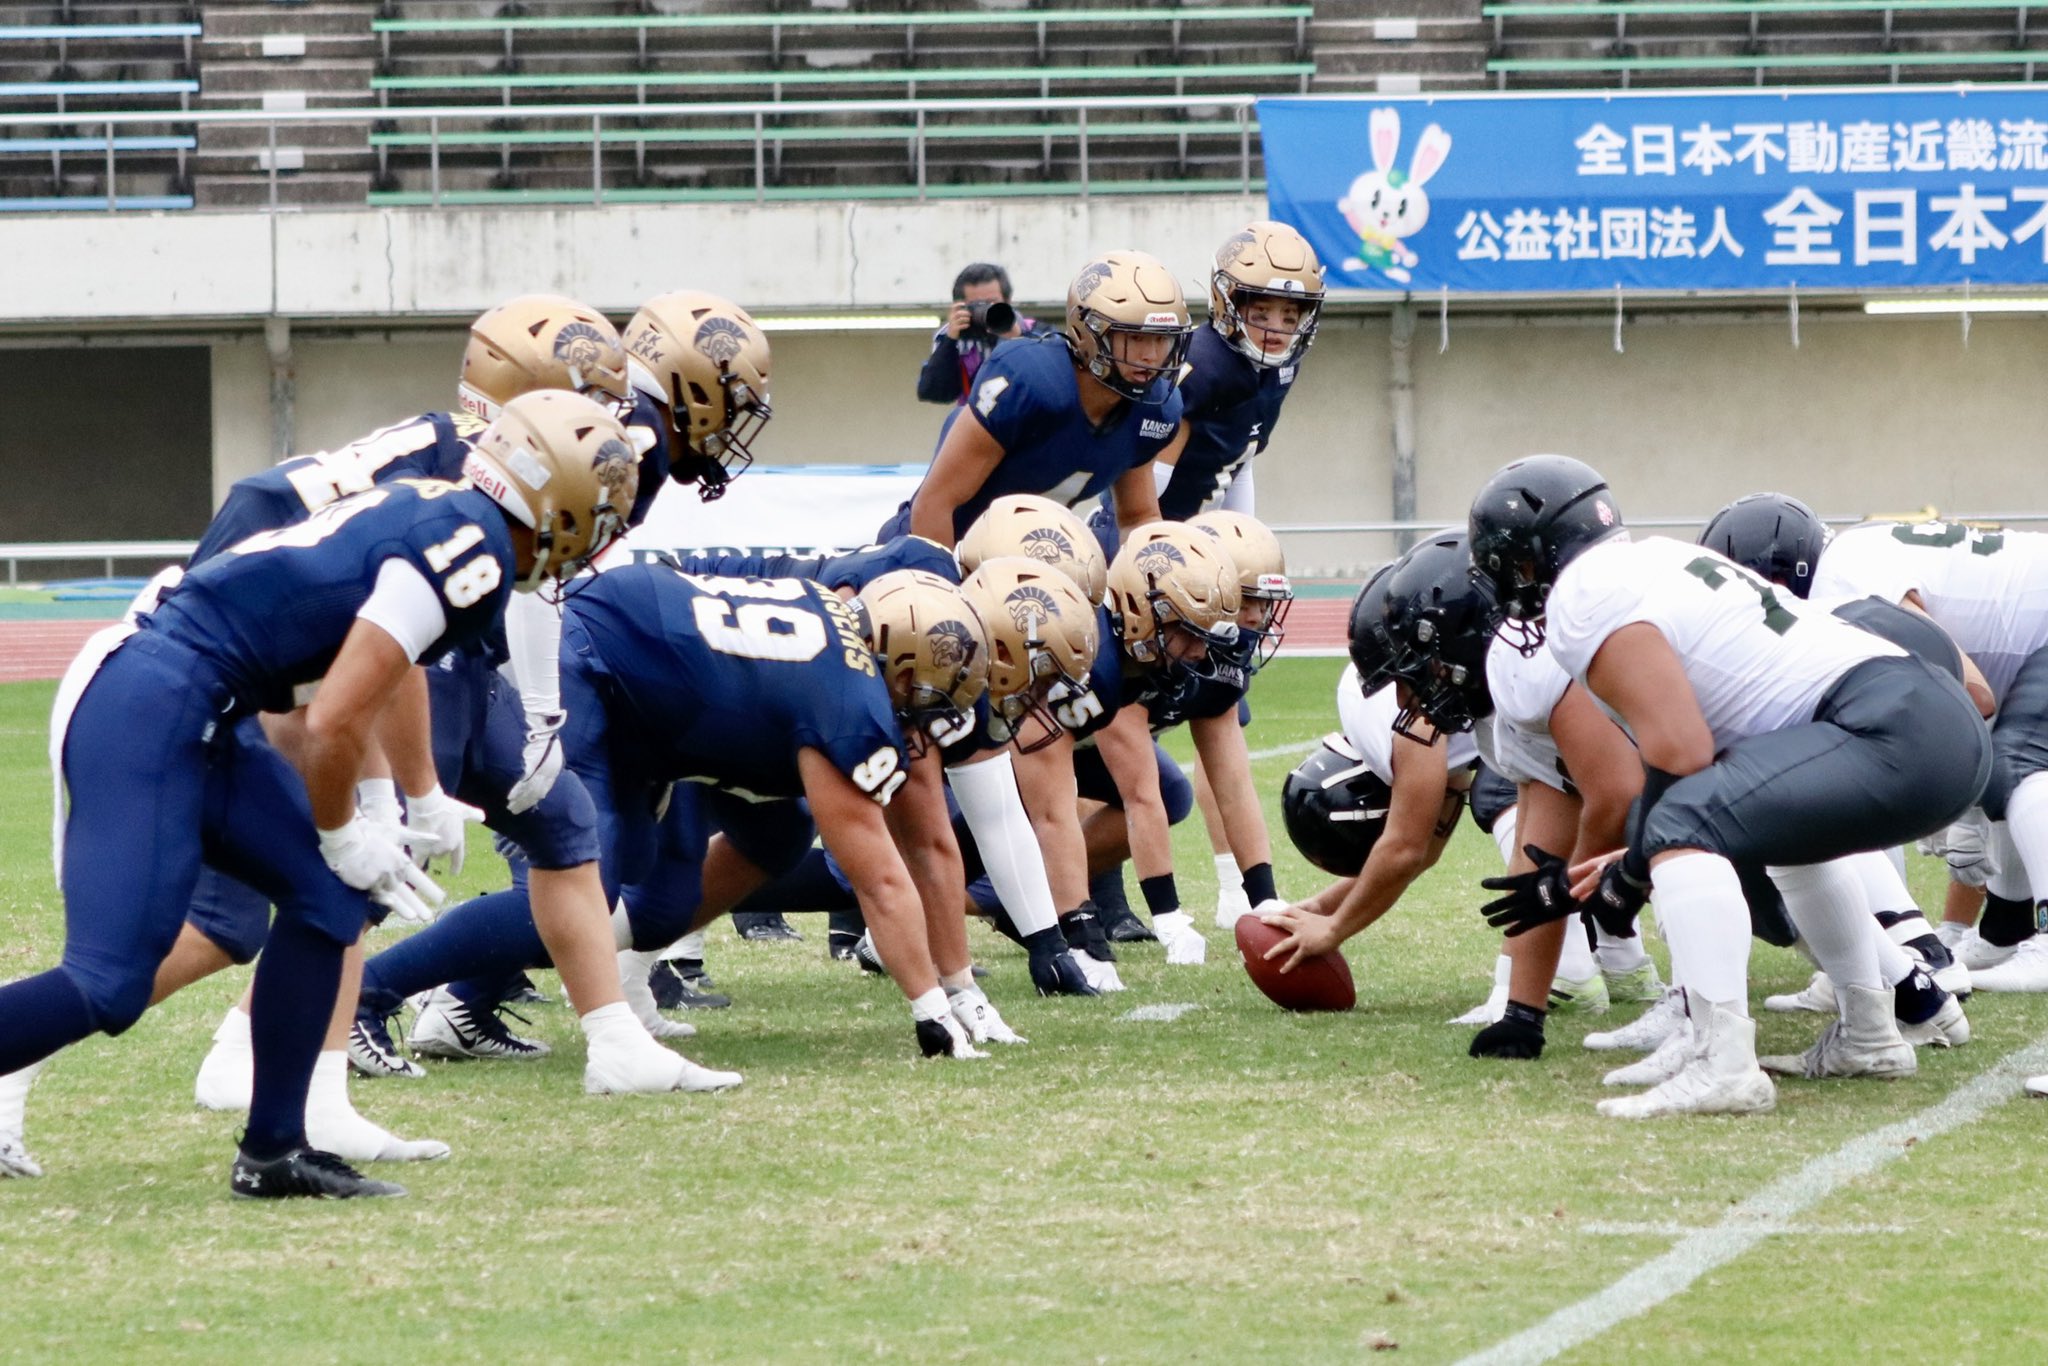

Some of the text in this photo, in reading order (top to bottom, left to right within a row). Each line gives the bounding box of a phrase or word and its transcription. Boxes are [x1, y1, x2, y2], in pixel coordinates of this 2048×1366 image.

[1574, 118, 2048, 176] 全日本不動産近畿流
[1455, 204, 1745, 262] 公益社団法人
[978, 376, 1009, 419] 4
[424, 523, 502, 609] 18
